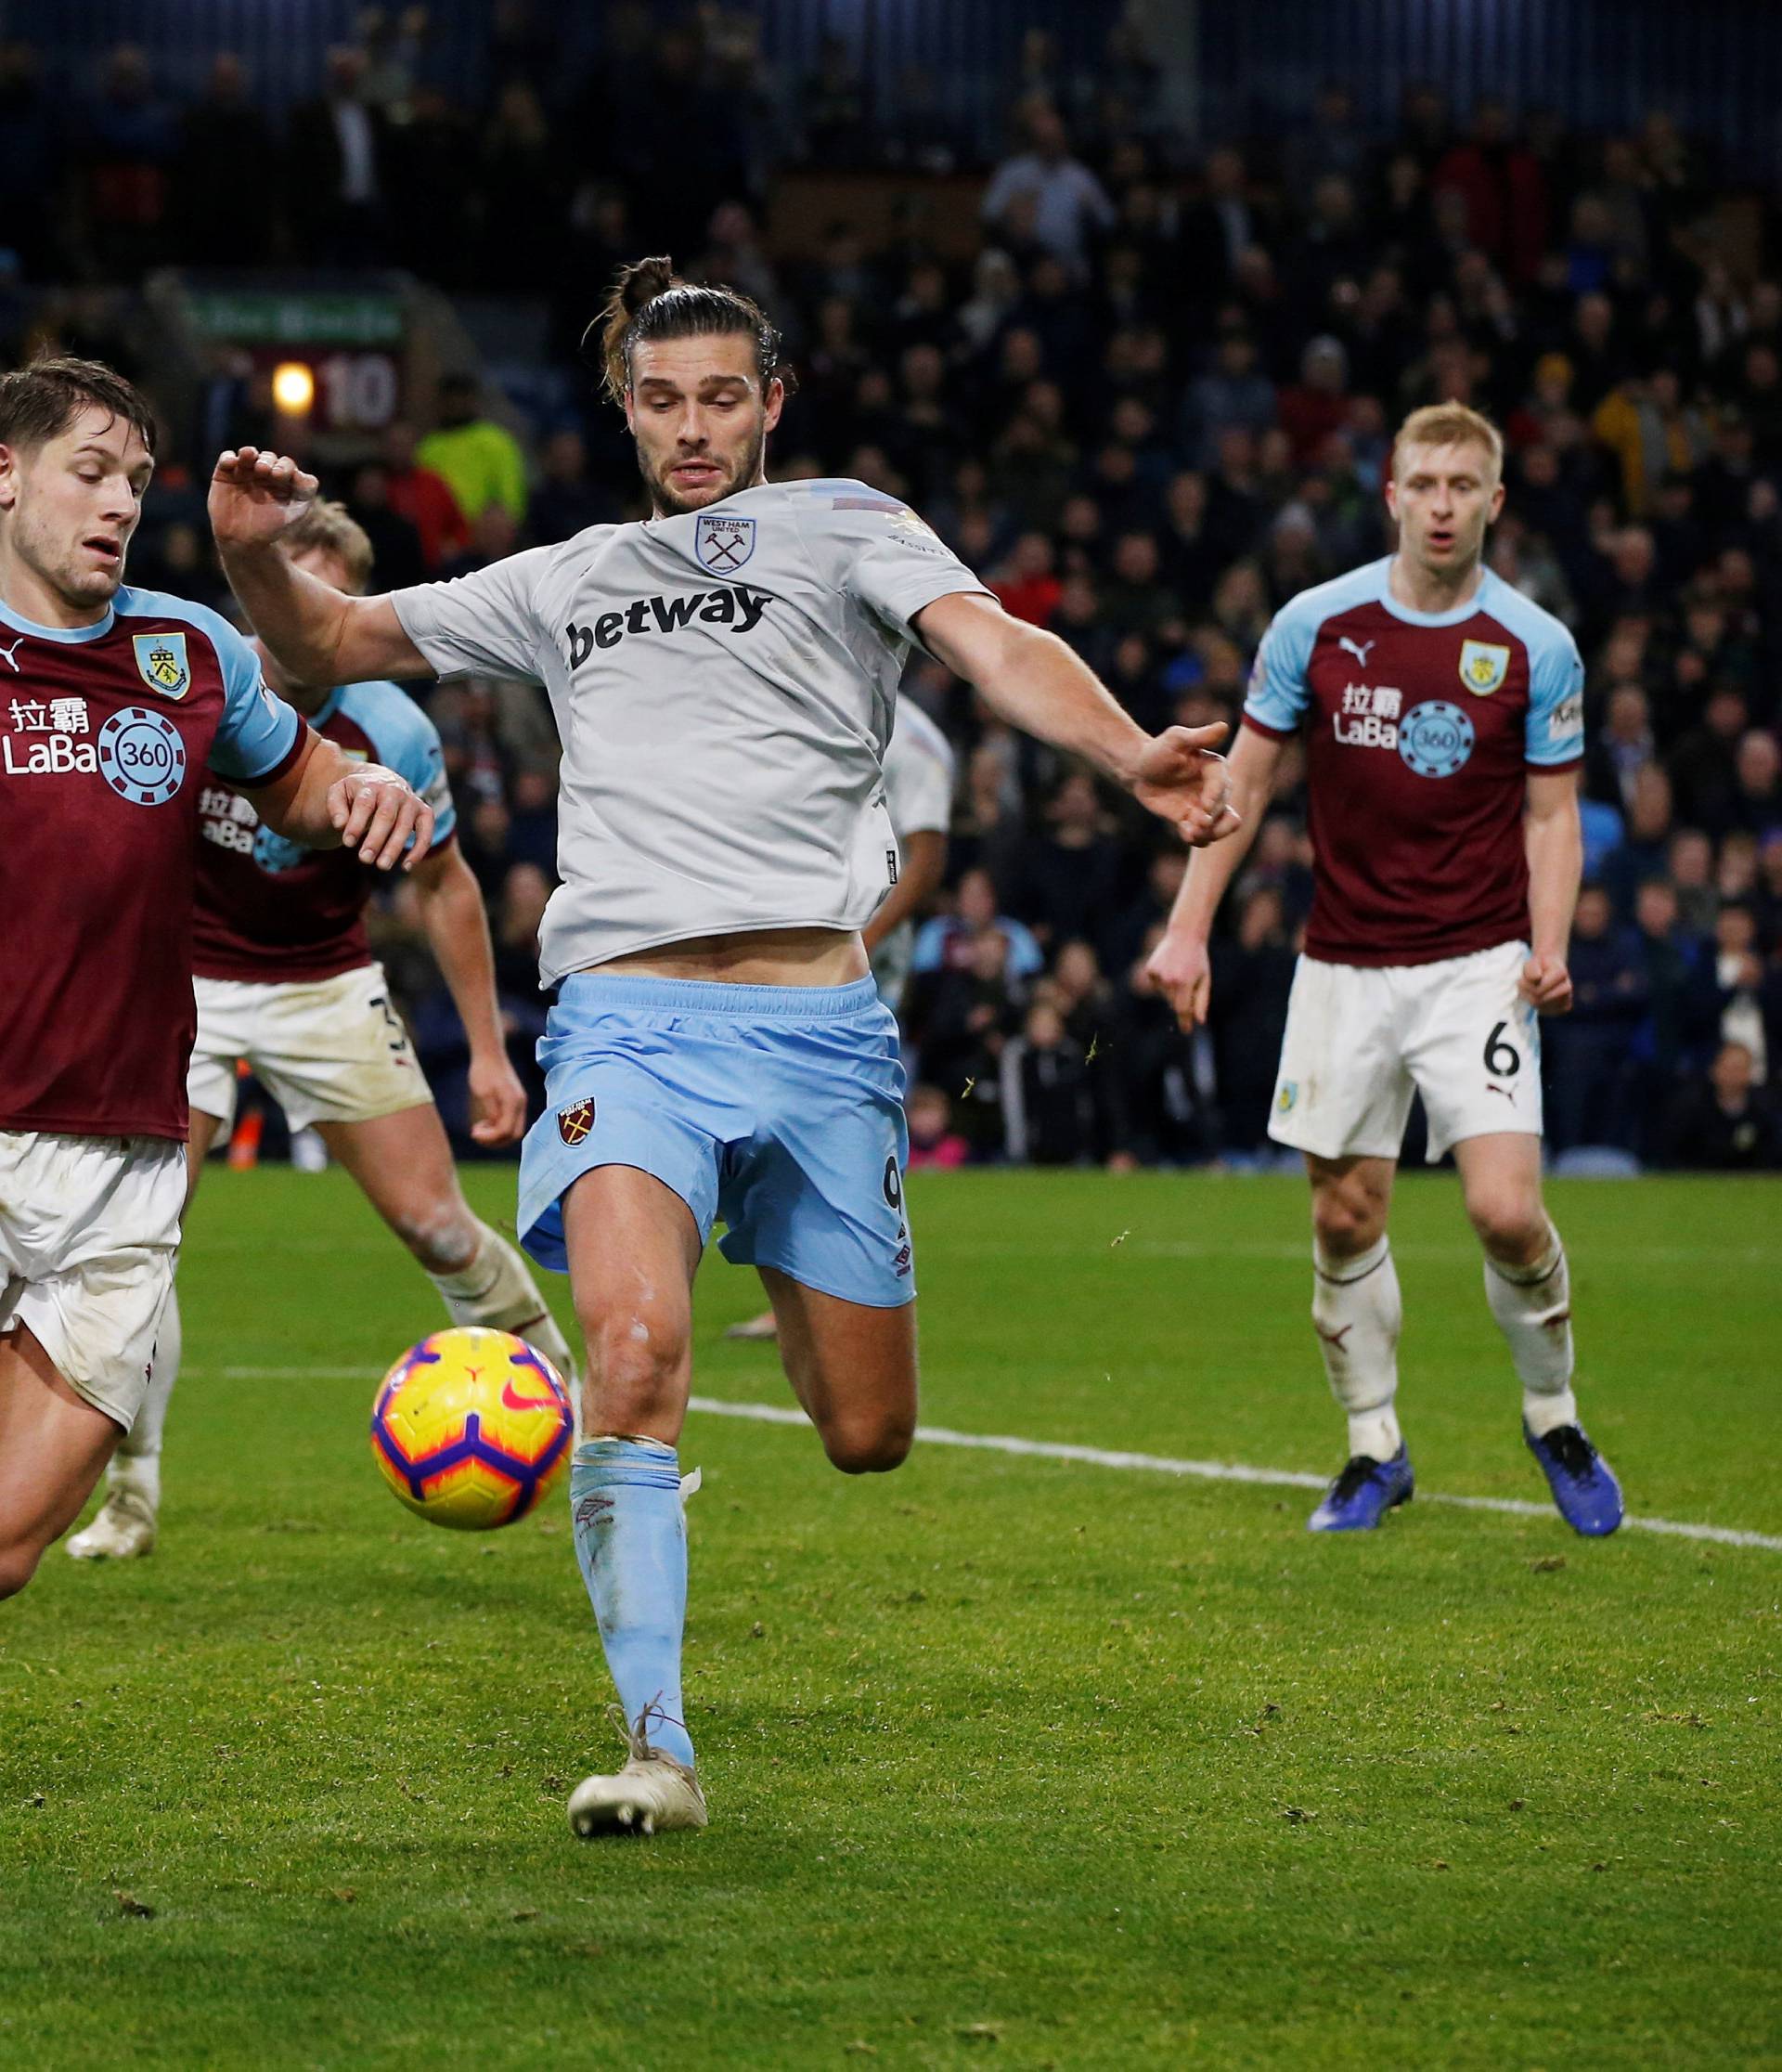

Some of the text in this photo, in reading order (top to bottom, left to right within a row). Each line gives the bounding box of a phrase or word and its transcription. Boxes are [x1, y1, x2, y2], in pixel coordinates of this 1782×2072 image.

[703, 519, 750, 529] WEST HAM
[565, 588, 773, 671] betway
[8, 697, 90, 733] 拉霸
[1333, 711, 1398, 750] LaBa
[2, 734, 169, 774] LaBa 360
[1484, 1021, 1520, 1077] 6
[883, 1155, 906, 1239] 9
